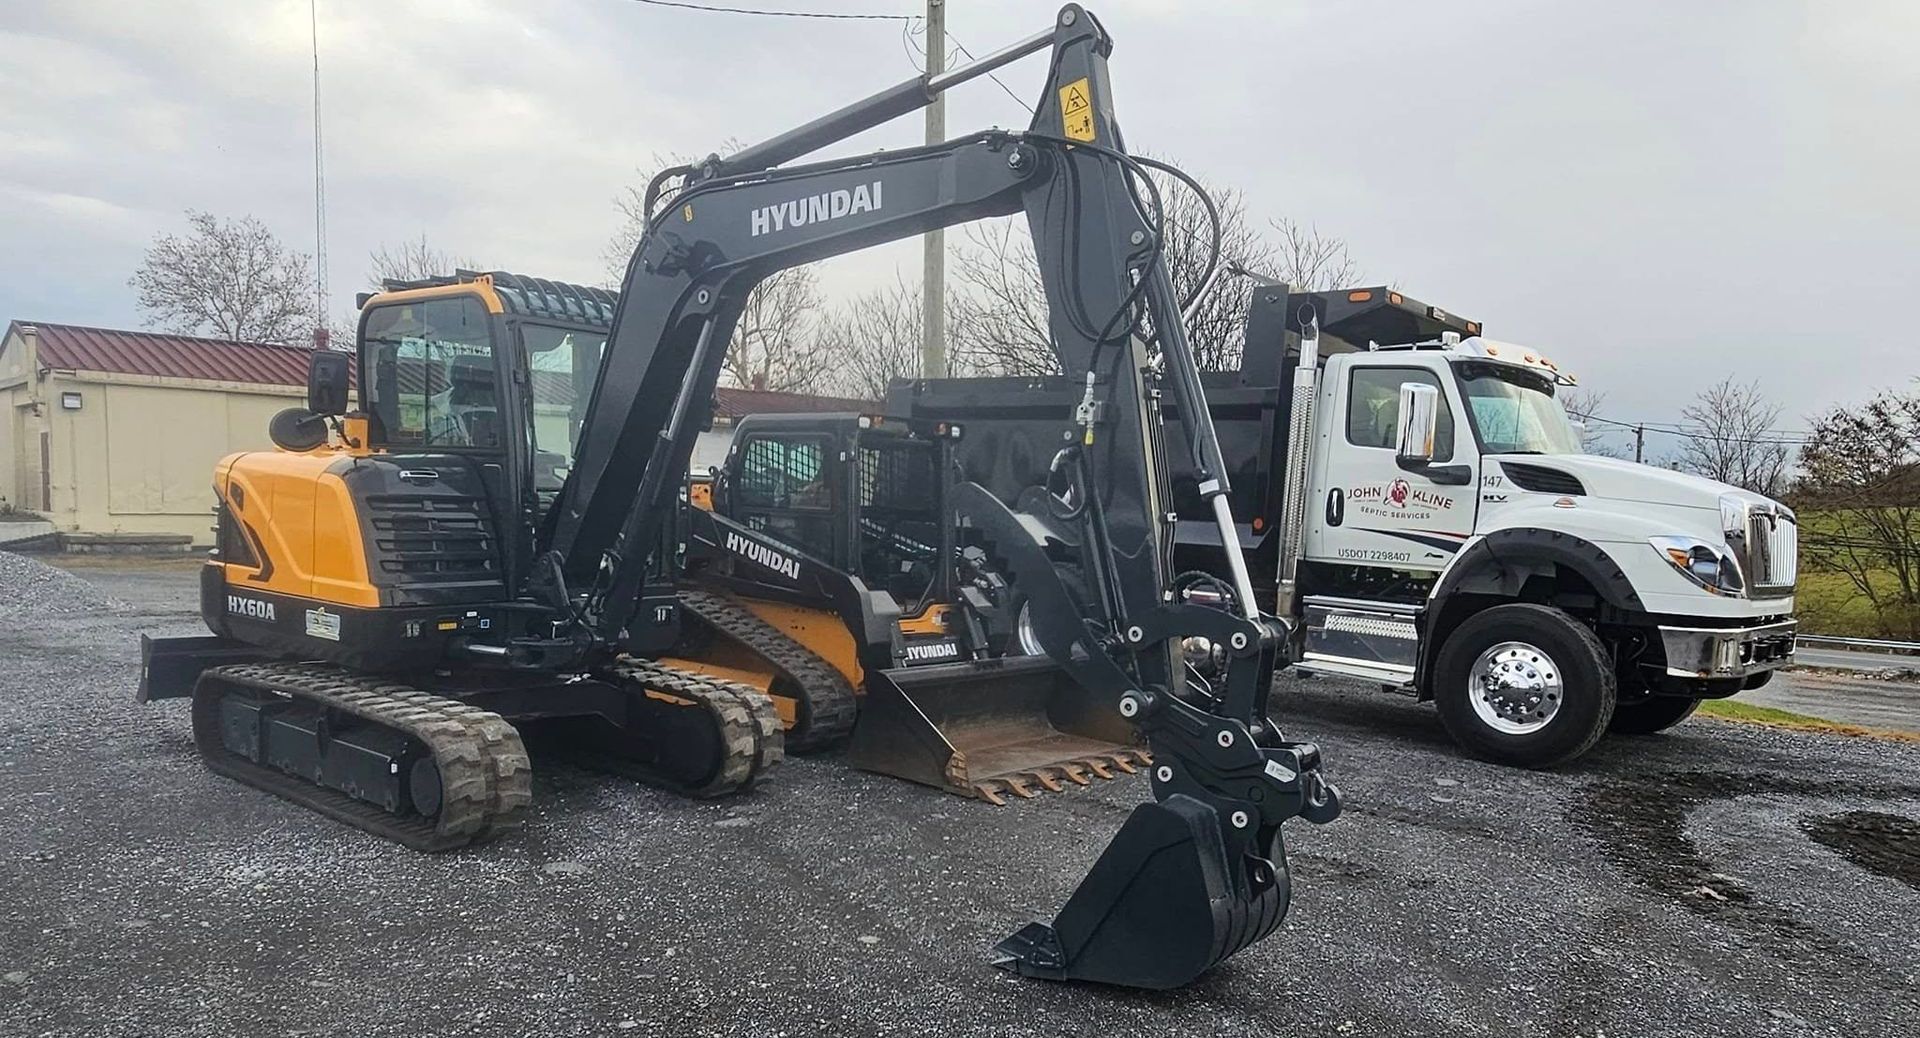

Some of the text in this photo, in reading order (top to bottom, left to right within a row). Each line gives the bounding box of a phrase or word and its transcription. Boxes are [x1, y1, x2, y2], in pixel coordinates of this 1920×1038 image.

[751, 181, 882, 237] HYUNDAI
[1483, 476, 1502, 488] 147
[1347, 487, 1381, 499] JOHN
[1412, 490, 1453, 510] KLINE
[1360, 506, 1431, 520] SEPTIC SERVICES
[726, 531, 801, 580] HYUNDAI
[1338, 548, 1367, 559] USDOT
[228, 595, 276, 620] HX60A
